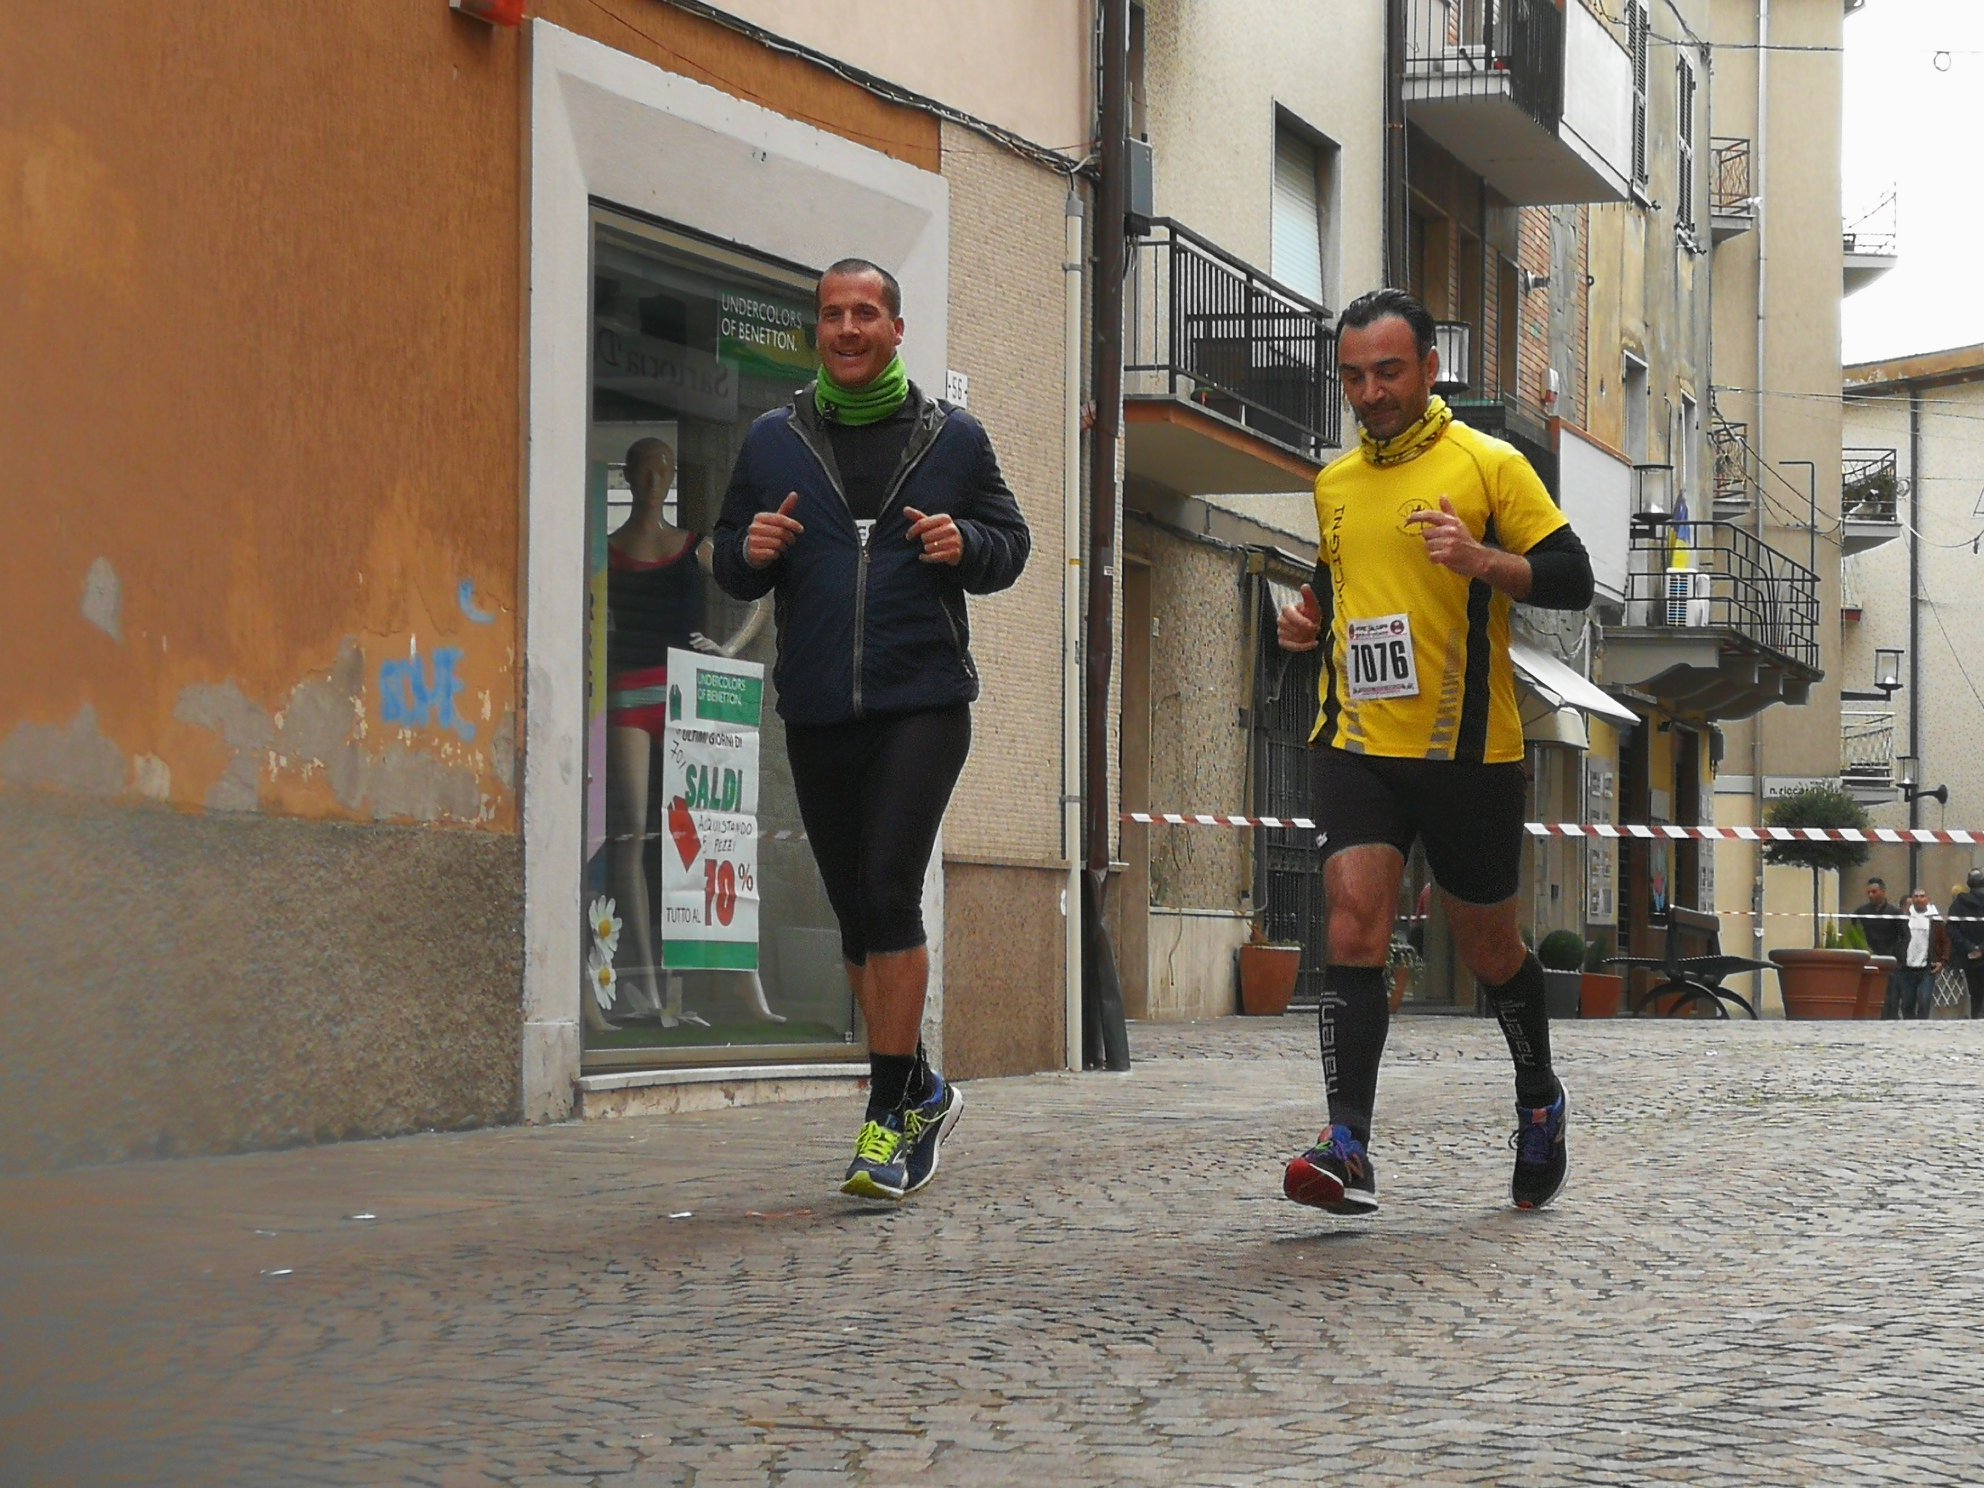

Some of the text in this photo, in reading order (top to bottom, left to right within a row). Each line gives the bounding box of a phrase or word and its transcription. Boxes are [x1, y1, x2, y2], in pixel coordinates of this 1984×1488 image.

[721, 293, 802, 329] UNDERCOLORS
[721, 317, 798, 352] OF BENETTON.
[685, 764, 743, 813] SALDI
[666, 907, 701, 923] TUTTO AL
